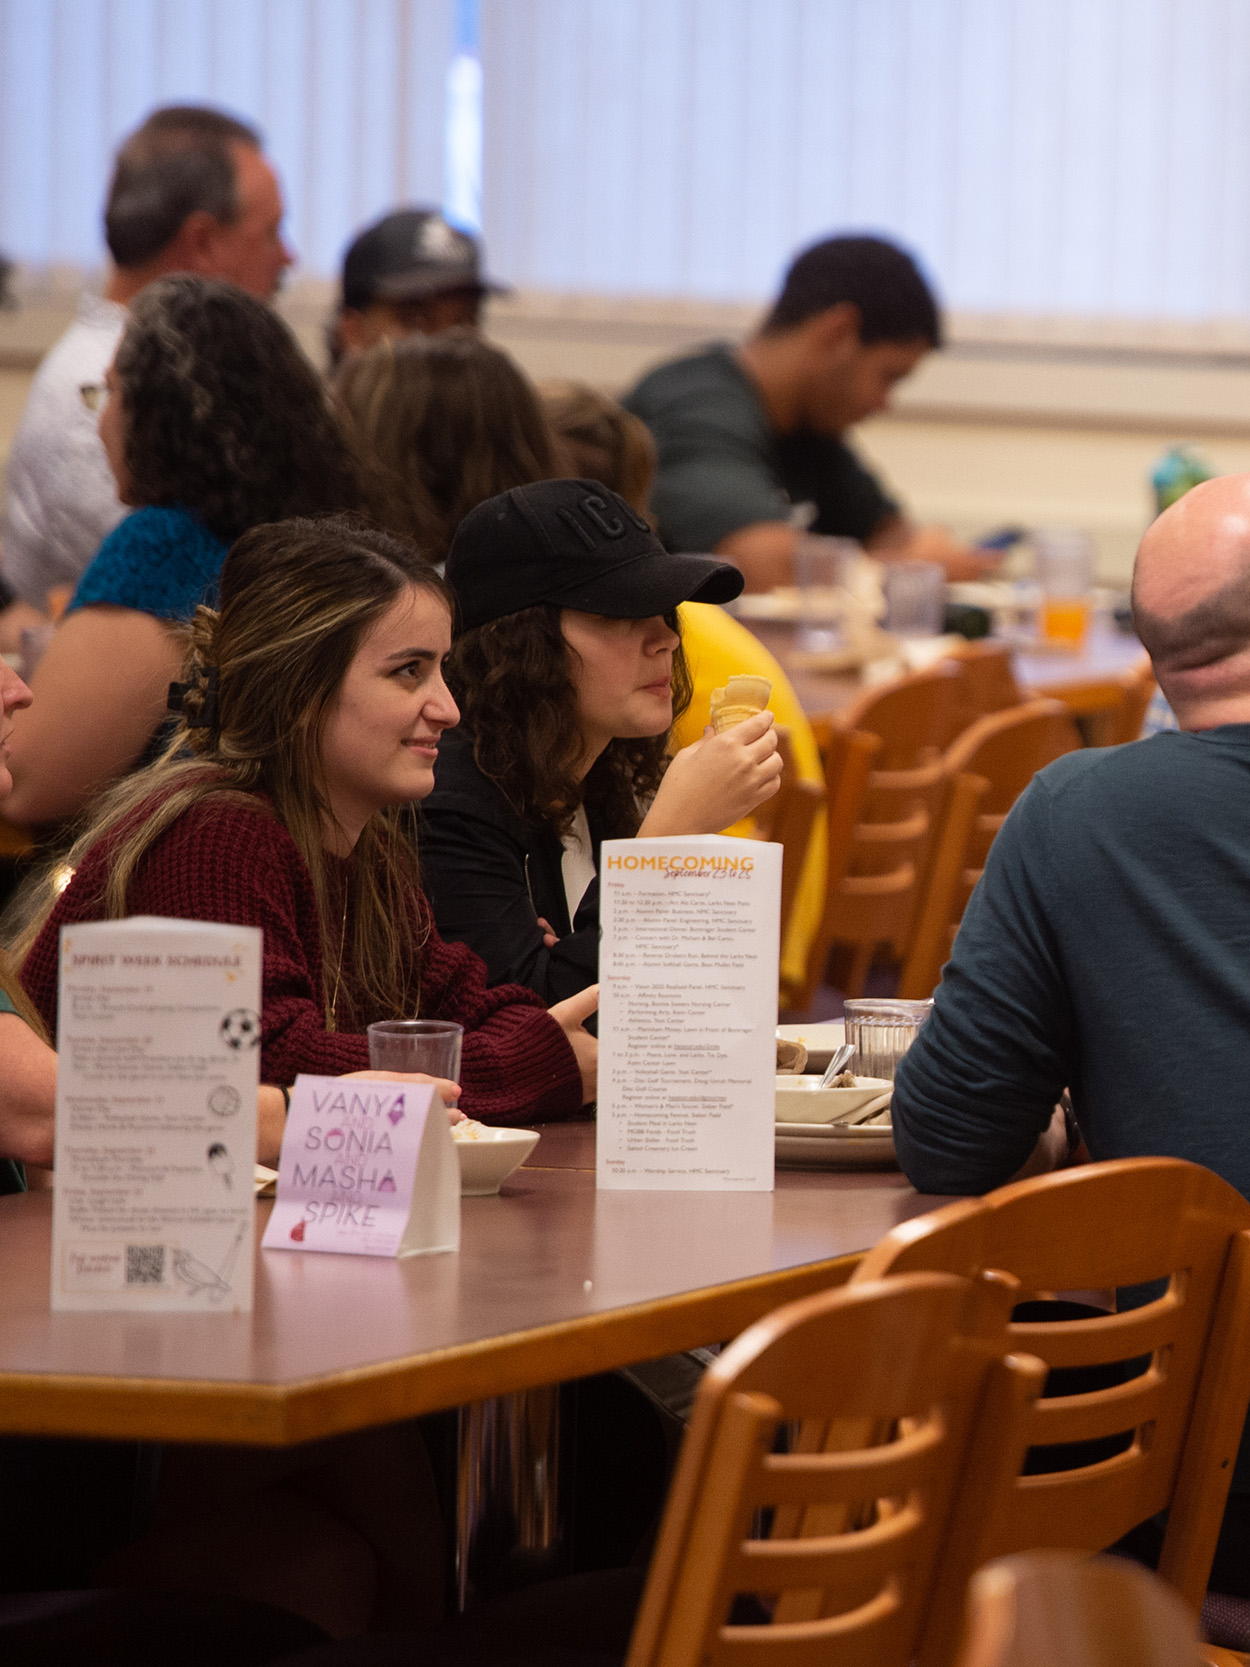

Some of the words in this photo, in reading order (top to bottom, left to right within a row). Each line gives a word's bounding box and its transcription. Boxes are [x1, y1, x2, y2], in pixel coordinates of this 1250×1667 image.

[607, 855, 754, 871] HOMECOMING
[663, 865, 711, 880] September
[712, 866, 727, 879] 23
[738, 867, 752, 880] 25
[313, 1090, 406, 1122] VANYA
[305, 1126, 394, 1156] SONIA
[292, 1163, 397, 1193] MASHA
[302, 1200, 381, 1227] SPIKE
